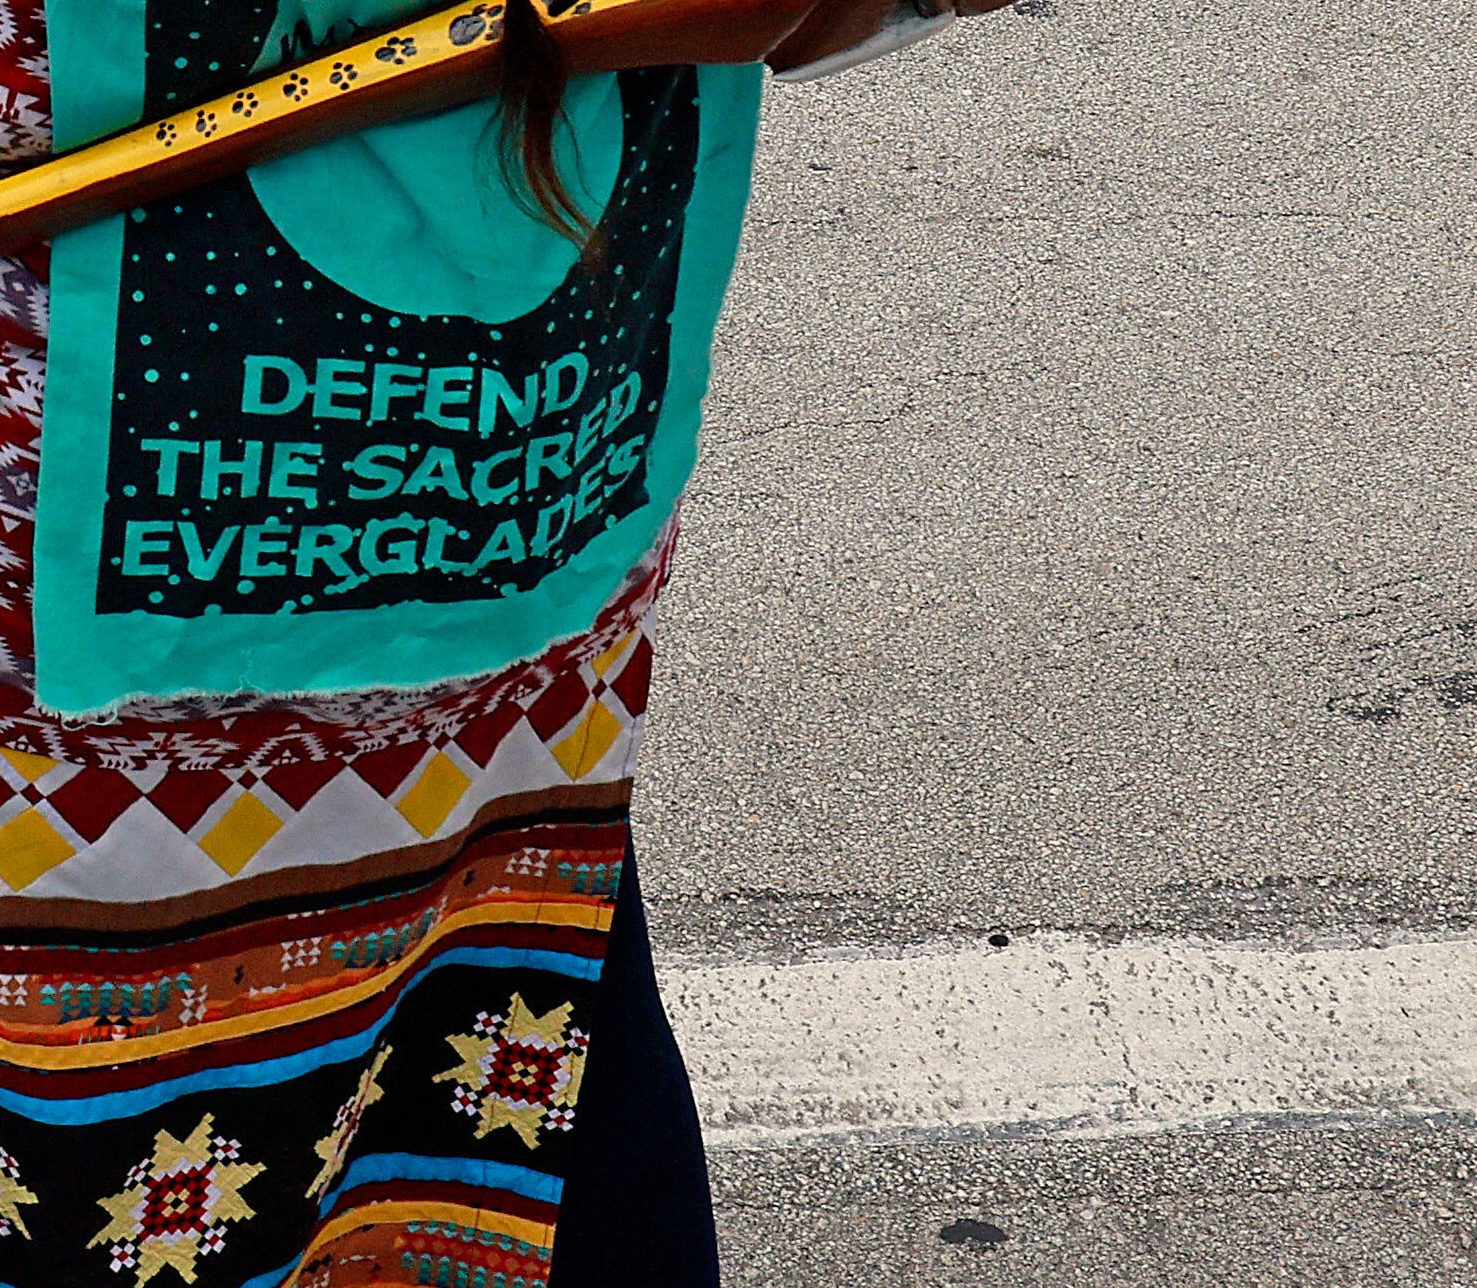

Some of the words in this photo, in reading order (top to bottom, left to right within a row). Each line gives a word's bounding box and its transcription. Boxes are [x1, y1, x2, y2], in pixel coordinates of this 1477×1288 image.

[139, 439, 324, 510] THE
[343, 369, 644, 507] SACRED
[240, 352, 590, 440] DEFEND
[119, 432, 647, 587] EVERGLADES
